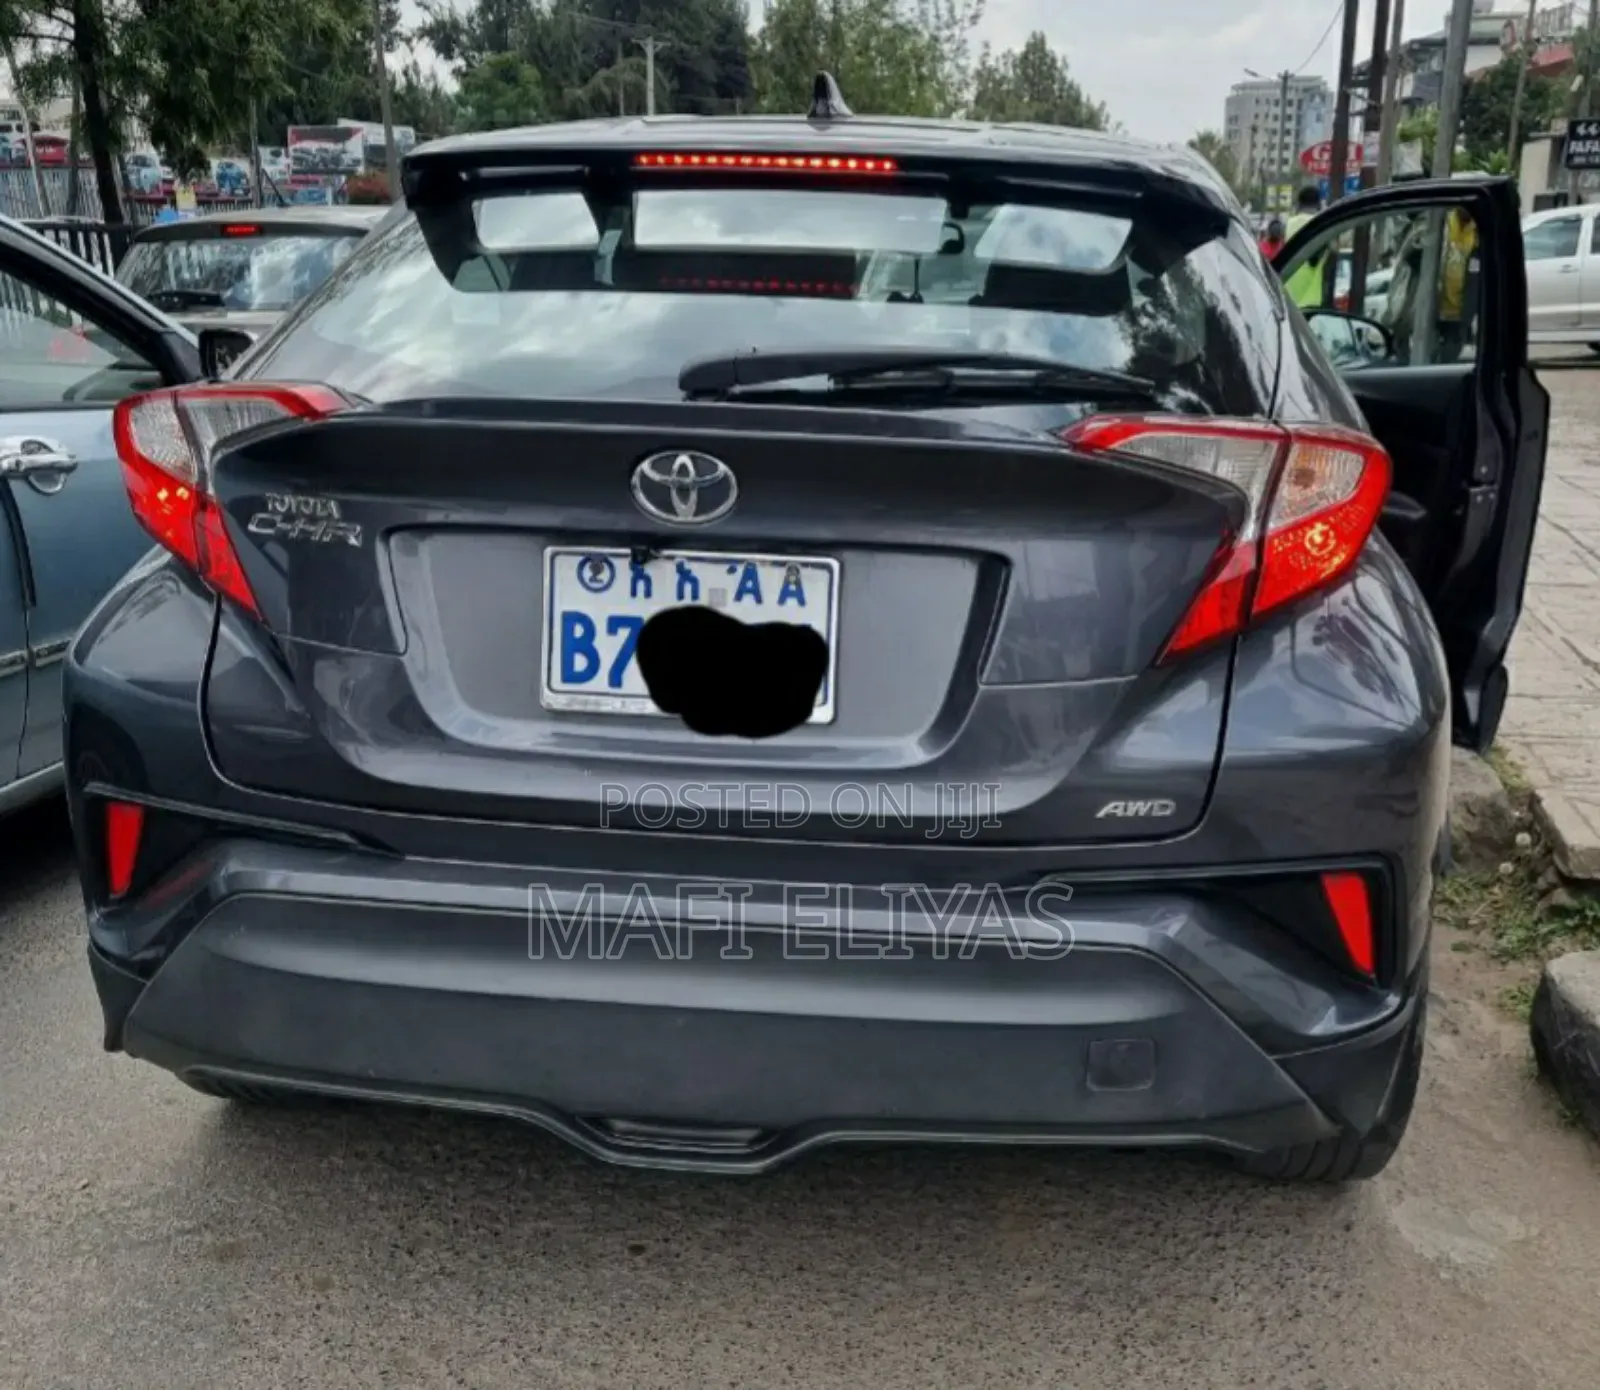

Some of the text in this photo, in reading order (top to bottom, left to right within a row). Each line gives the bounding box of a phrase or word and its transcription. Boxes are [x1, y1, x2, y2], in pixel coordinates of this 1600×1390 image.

[264, 492, 340, 519] TOYOTA
[247, 512, 362, 547] C-HR
[1095, 799, 1177, 819] AWD
